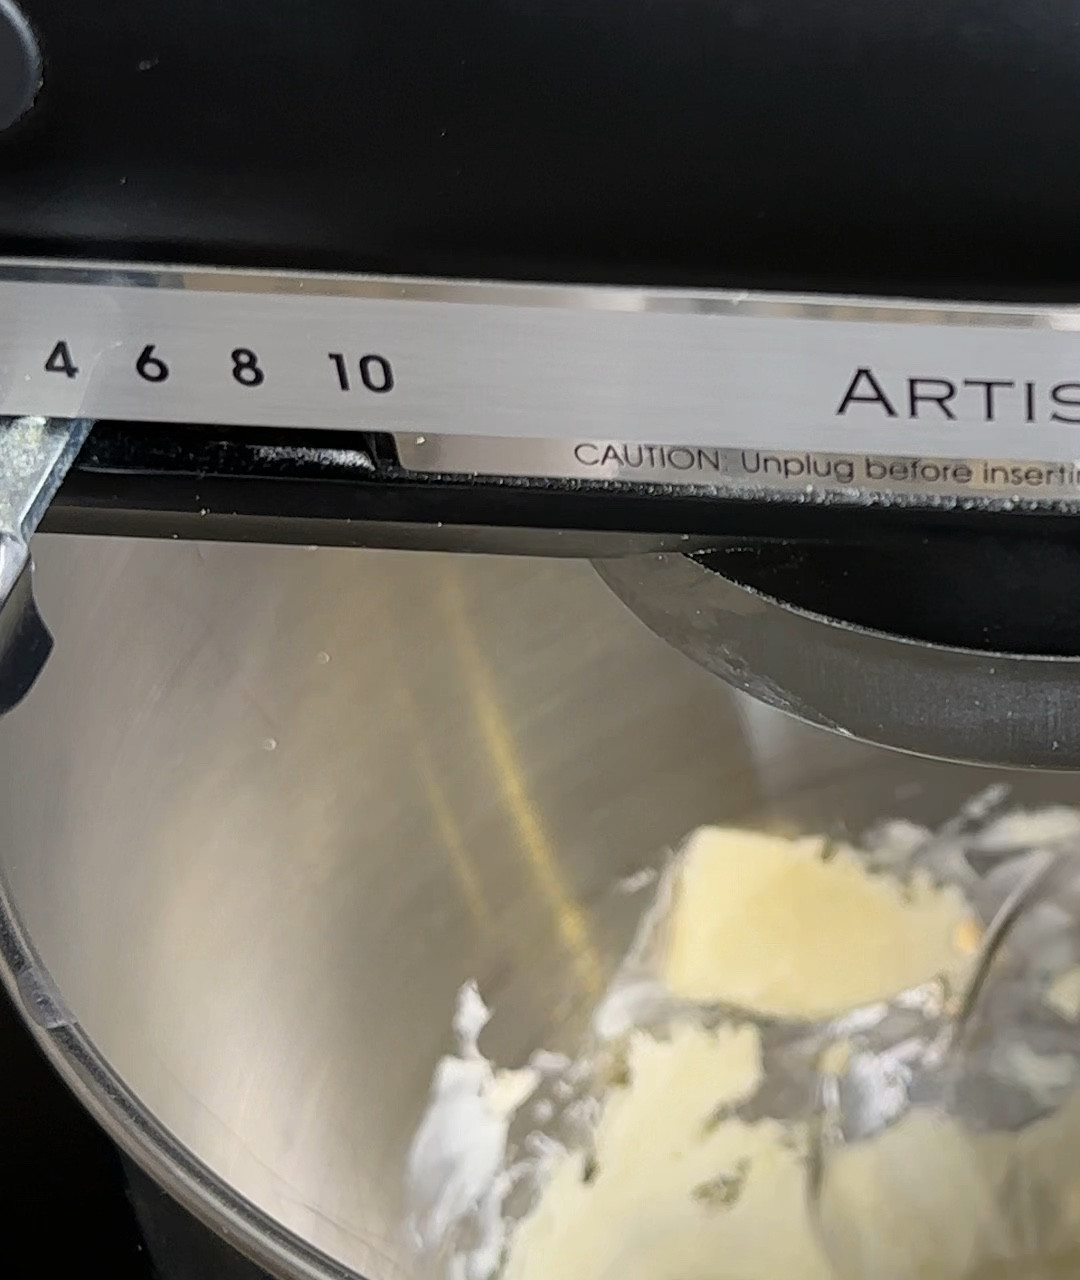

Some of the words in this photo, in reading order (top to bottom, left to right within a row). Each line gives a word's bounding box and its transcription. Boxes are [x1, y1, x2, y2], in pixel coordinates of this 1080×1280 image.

[45, 340, 79, 378] 4
[136, 345, 169, 382] 6
[231, 348, 264, 386] 8
[328, 353, 394, 393] 10
[742, 452, 854, 483] Unplug
[865, 457, 972, 482] before
